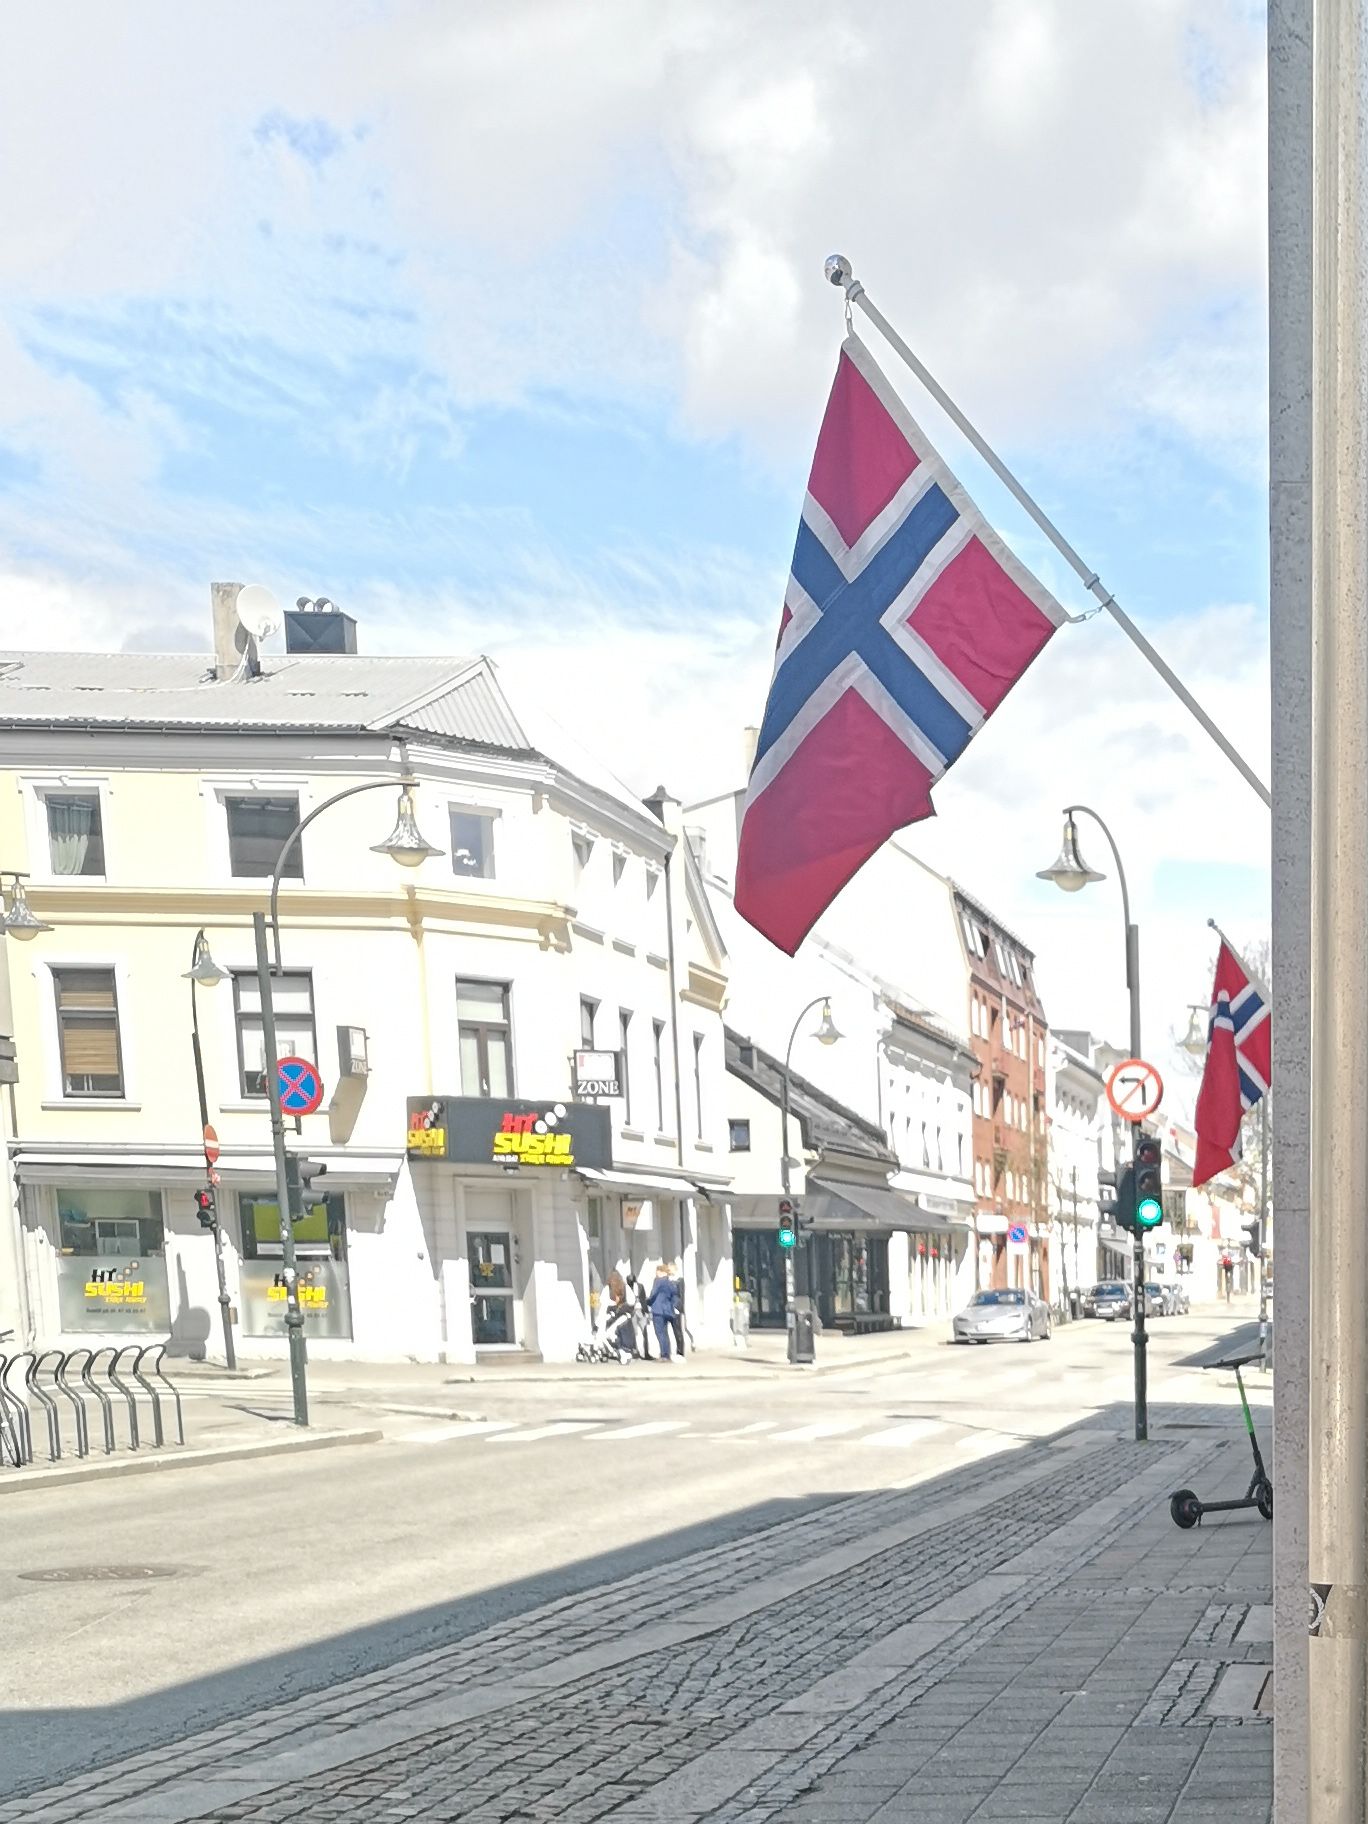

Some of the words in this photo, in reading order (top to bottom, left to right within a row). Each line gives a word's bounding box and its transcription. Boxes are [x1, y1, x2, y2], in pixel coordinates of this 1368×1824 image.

[577, 1080, 619, 1095] ZONE
[493, 1132, 571, 1154] SUSHI
[84, 1281, 144, 1297] SUSHI
